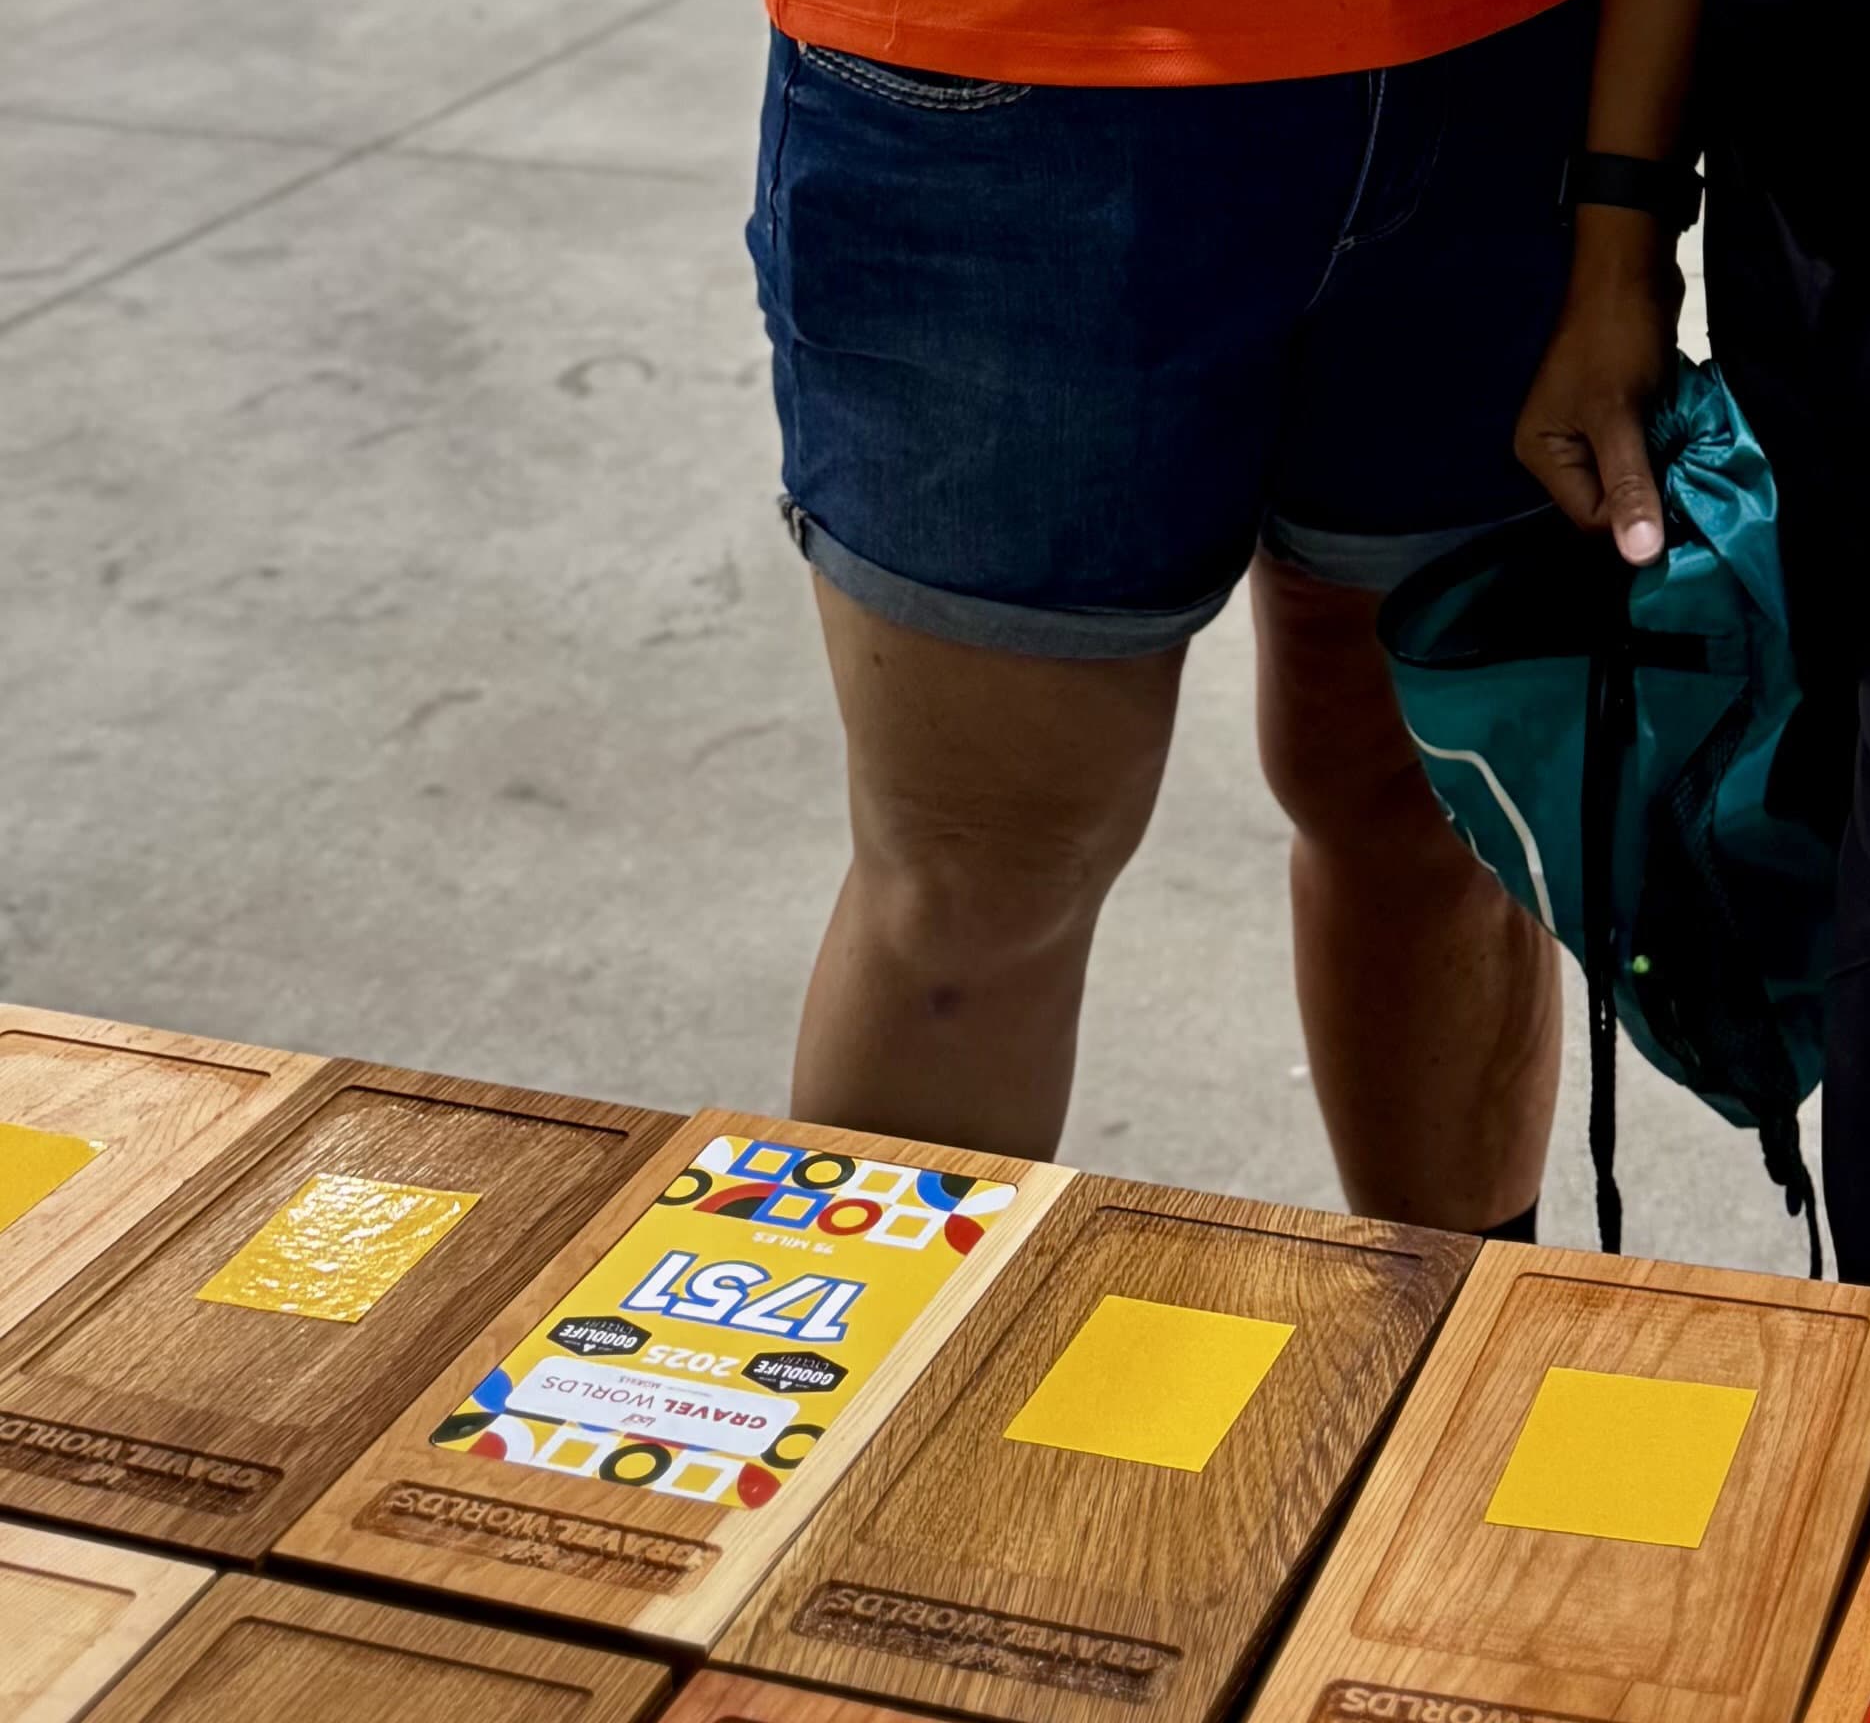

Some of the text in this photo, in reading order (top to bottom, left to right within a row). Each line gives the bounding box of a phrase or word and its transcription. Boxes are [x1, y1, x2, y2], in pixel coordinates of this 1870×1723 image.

[750, 1231, 811, 1251] MILES
[618, 1249, 867, 1344] 1751
[556, 1323, 639, 1352] GOODLIFE
[638, 1342, 743, 1378] 2025
[752, 1359, 835, 1388] GOODLIFE
[540, 1374, 769, 1430] GRAVEL WORLDS
[126, 1444, 264, 1490] GRAVEL
[393, 1486, 706, 1569] GRAVEL WORLDS
[825, 1585, 1001, 1647] WORLDS
[1338, 1686, 1522, 1723] WORLDS
